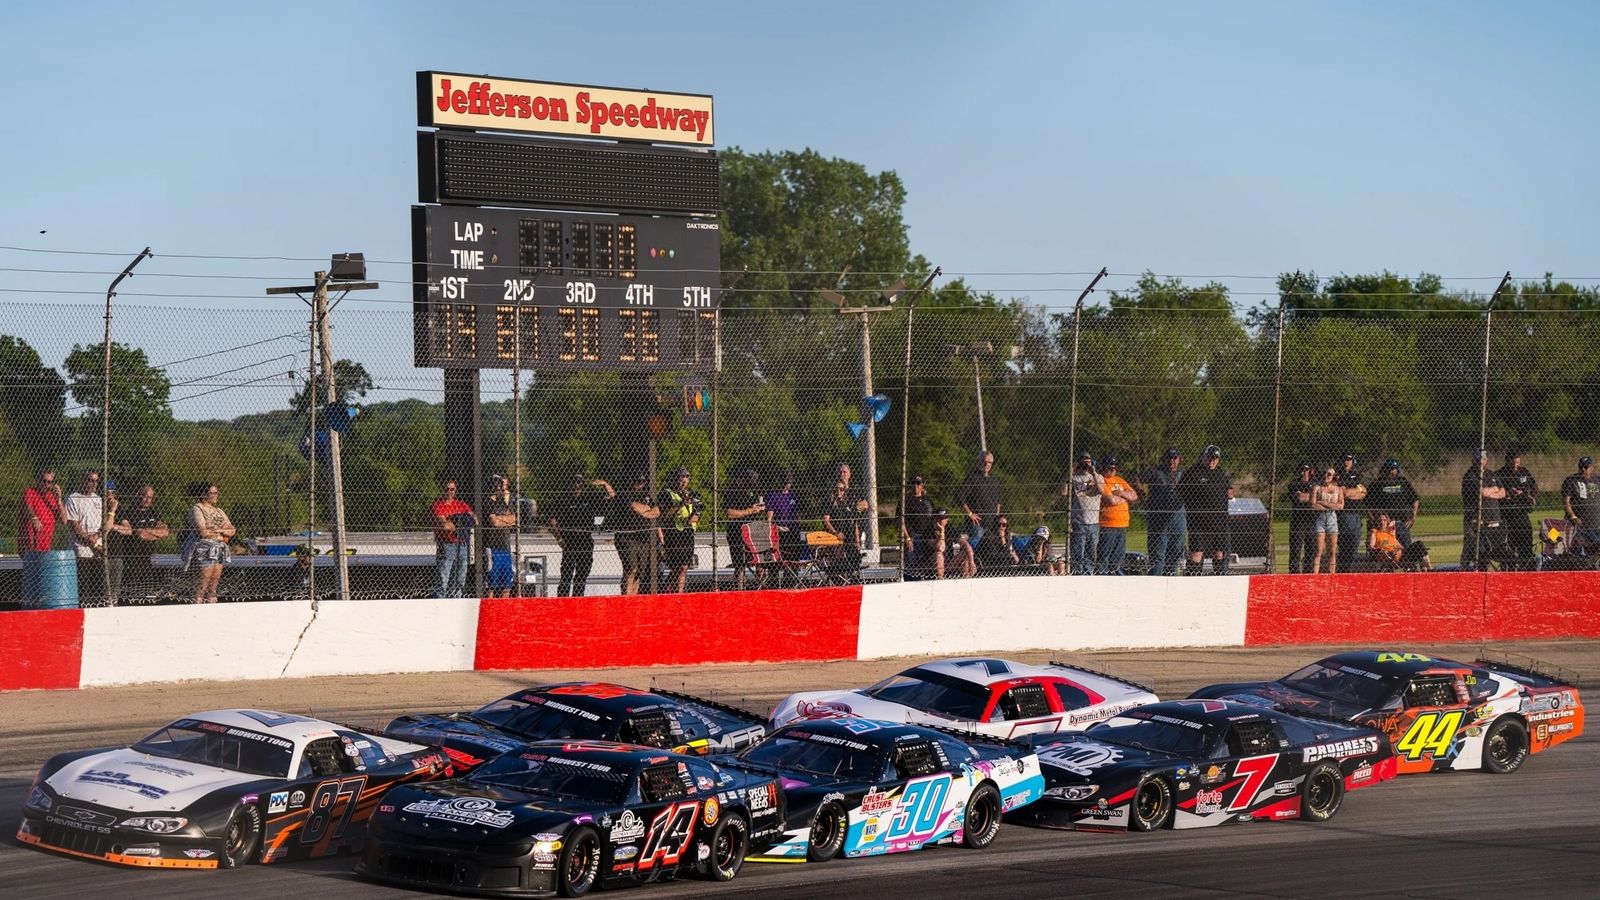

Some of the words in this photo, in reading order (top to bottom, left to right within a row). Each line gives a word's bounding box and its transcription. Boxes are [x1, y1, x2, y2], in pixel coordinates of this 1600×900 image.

[436, 78, 569, 122] Jefferson
[576, 91, 709, 141] Speedway
[453, 221, 484, 242] LAP
[686, 222, 719, 230] DAKTRONICS
[450, 249, 484, 270] TIME
[440, 277, 468, 299] 1ST
[503, 279, 535, 301] 2ND
[565, 282, 597, 304] 3RD
[624, 284, 654, 305] 4TH
[683, 286, 711, 307] 5TH
[544, 700, 580, 715] MIDWEST
[578, 709, 601, 721] TOUR
[1069, 712, 1099, 726] Dynamic
[1100, 707, 1118, 718] Metal
[1151, 714, 1185, 725] MIDWEST
[1182, 720, 1203, 730] TOUR
[227, 728, 268, 742] MIDWEST
[268, 737, 292, 749] TOUR
[809, 734, 847, 745] MIDWEST
[845, 740, 868, 751] TOUR
[1396, 709, 1467, 762] 44
[547, 756, 588, 768] MIDWEST
[586, 763, 612, 773] TOUR
[1227, 753, 1280, 812] 7
[269, 793, 288, 807] PDC
[748, 785, 769, 800] SPECIAL
[863, 793, 885, 804] CRUST
[301, 775, 368, 845] 87
[861, 799, 892, 812] BUSTERS
[885, 773, 954, 841] 30
[1081, 807, 1103, 816] GREEN
[1103, 808, 1124, 817] SWAN
[46, 815, 97, 832] CHEVROLET
[97, 826, 111, 834] SS
[430, 811, 473, 823] RACING
[639, 802, 699, 864] 14
